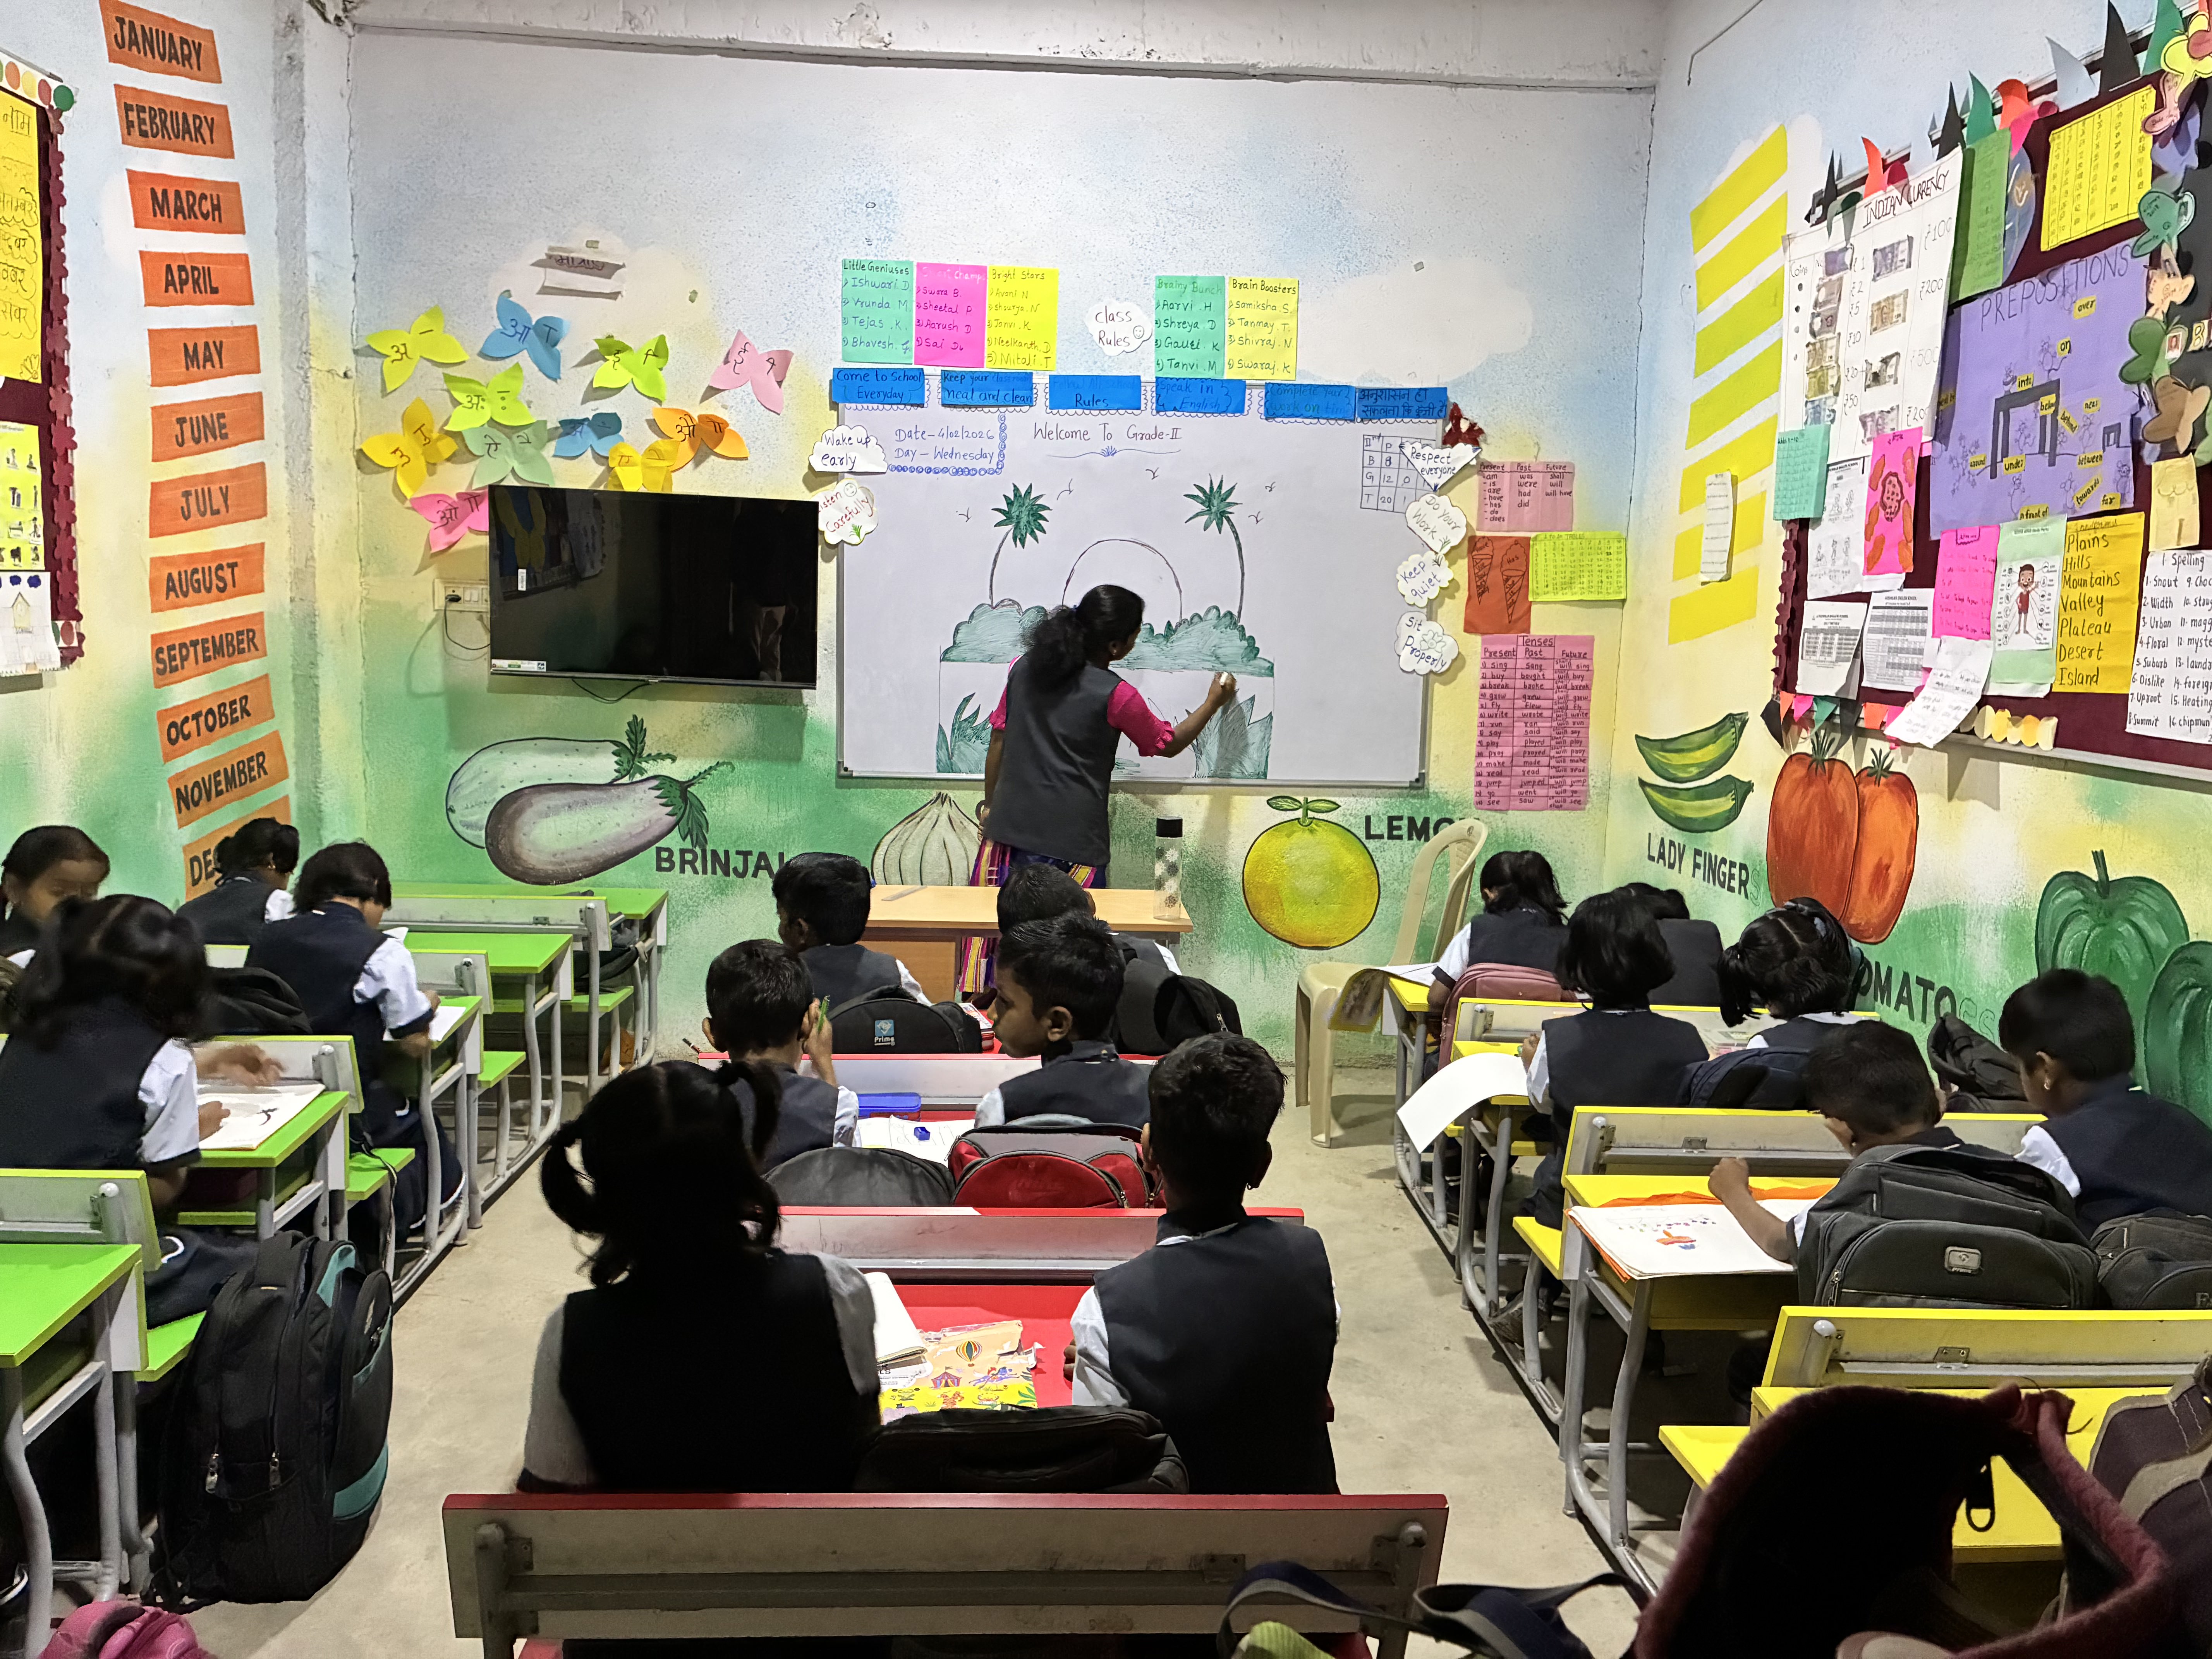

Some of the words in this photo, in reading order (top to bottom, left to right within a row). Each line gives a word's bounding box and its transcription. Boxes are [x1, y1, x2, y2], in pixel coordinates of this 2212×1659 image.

[113, 15, 202, 71] JANUARY
[124, 101, 215, 144] FEBRUARY
[1863, 197, 1903, 228] INDIAN
[1908, 166, 1949, 204] CURRENCY
[150, 188, 222, 223] MARCH
[844, 259, 866, 270] Little
[868, 261, 909, 275] Geniuses
[993, 268, 1015, 282] Bright
[1021, 269, 1045, 280] Stars
[164, 264, 219, 294] APRIL
[1158, 279, 1187, 294] Brainy
[1192, 281, 1222, 295] Bunch
[1233, 279, 1258, 290] Brain
[1261, 280, 1296, 294] Boosters
[922, 287, 948, 295] Swara
[1981, 244, 2131, 331] PREPOSITIONS
[852, 297, 890, 308] Vrunda
[2078, 299, 2095, 312] over
[501, 318, 531, 344] आ
[852, 316, 883, 330] Tejas
[925, 319, 958, 332] Aarush
[1238, 318, 1274, 334] Tanmay
[925, 338, 945, 349] Sai
[1099, 330, 1130, 347] Rules
[183, 340, 223, 370] MAY
[391, 343, 413, 363] अ
[2060, 340, 2071, 354] on
[837, 370, 869, 381] Come
[876, 370, 887, 381] to
[891, 370, 921, 382] School
[944, 372, 965, 384] Keep
[970, 373, 989, 386] your
[858, 386, 903, 403] Everyday
[1160, 380, 1192, 394] Speak
[1200, 381, 1213, 394] in
[979, 389, 1000, 402] and
[1004, 388, 1032, 403] clean
[1075, 393, 1109, 407] Rules
[1180, 397, 1219, 412] English
[1305, 404, 1319, 414] on
[175, 413, 228, 447] JUNE
[1034, 422, 1091, 441] Welcome
[1099, 423, 1112, 441] To
[825, 432, 853, 446] Wake
[857, 437, 871, 448] up
[821, 453, 857, 470] early
[934, 446, 994, 464] Wednesday
[1410, 446, 1451, 464] Respect
[1421, 465, 1456, 479] everyone
[2004, 459, 2023, 471] under
[180, 485, 230, 521] JULY
[1425, 496, 1439, 510] Do
[2068, 534, 2109, 553] Plains
[2064, 555, 2092, 572] Hills
[2172, 553, 2204, 573] Spelling
[1401, 561, 1425, 583] Keep
[2063, 571, 2120, 589] Mountains
[165, 562, 238, 600] AUGUST
[1411, 572, 1441, 599] quiet
[2154, 575, 2178, 587] Snout
[2061, 592, 2104, 617] Valley
[2151, 596, 2173, 609] Width
[1405, 617, 1422, 631] Sit
[2060, 618, 2111, 638] Plateau
[2150, 616, 2171, 629] Urban
[1519, 635, 1553, 646] Tenses
[155, 628, 259, 677] SEPTEMBER
[1403, 635, 1447, 668] Properly
[1484, 647, 1516, 657] Present
[1525, 647, 1543, 656] Past
[1562, 650, 1587, 658] Future
[2059, 641, 2104, 662] Desert
[1491, 661, 1507, 672] sing
[1526, 663, 1542, 672] sang
[2143, 657, 2167, 668] Suburb
[1491, 672, 1504, 682] buy
[2059, 667, 2099, 685] Island
[2140, 675, 2165, 687] Dislike
[2137, 692, 2162, 706] Uproot
[167, 695, 251, 745] OCTOBER
[2133, 714, 2159, 726] Summit
[176, 750, 268, 814] NOVEMBER
[1365, 815, 1480, 842] LEMO
[1648, 833, 1686, 874] LADY
